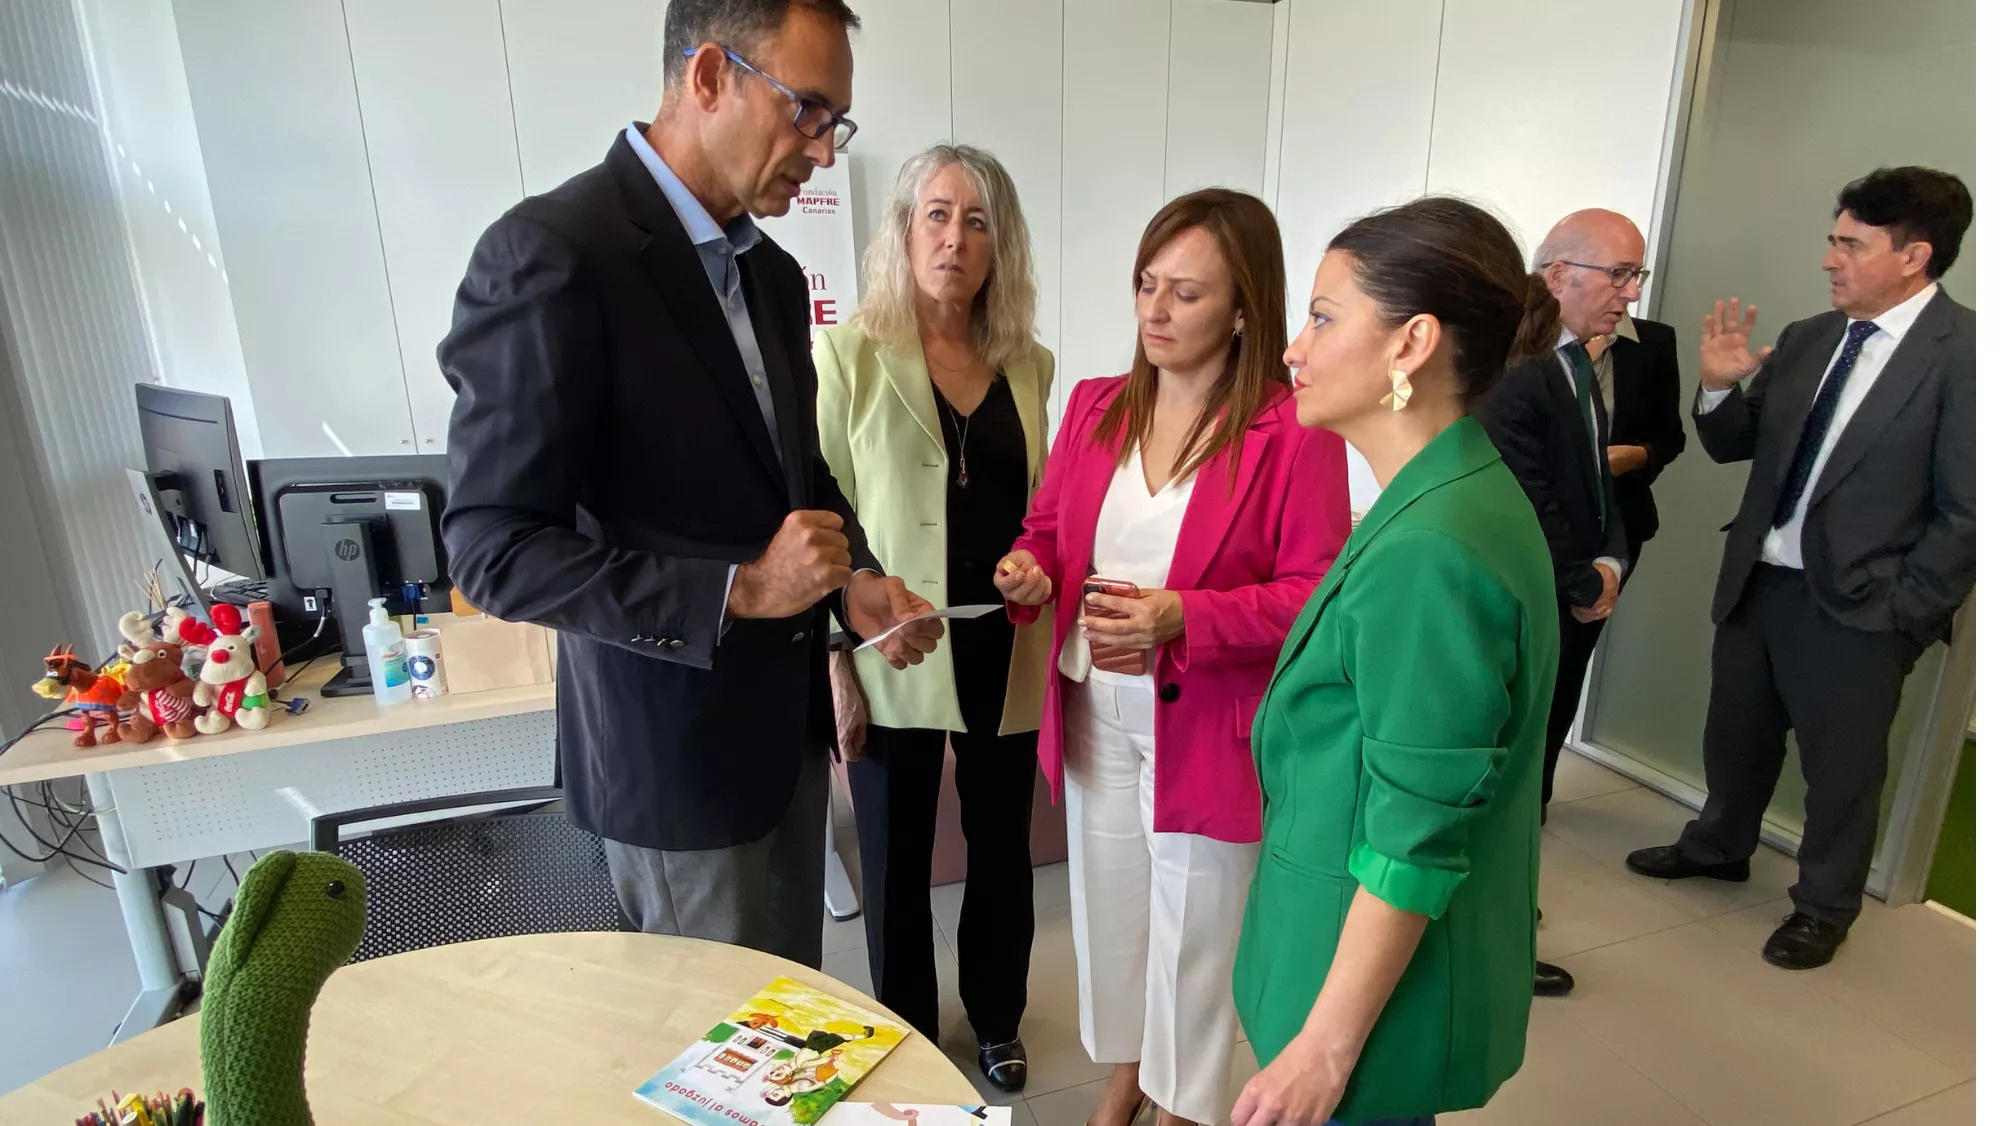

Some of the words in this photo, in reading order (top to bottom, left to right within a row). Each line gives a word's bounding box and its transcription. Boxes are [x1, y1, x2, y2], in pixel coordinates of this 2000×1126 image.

[797, 197, 840, 206] MAPFRE
[803, 206, 836, 214] Canarias
[338, 539, 358, 561] hp
[664, 1082, 713, 1108] juzgado
